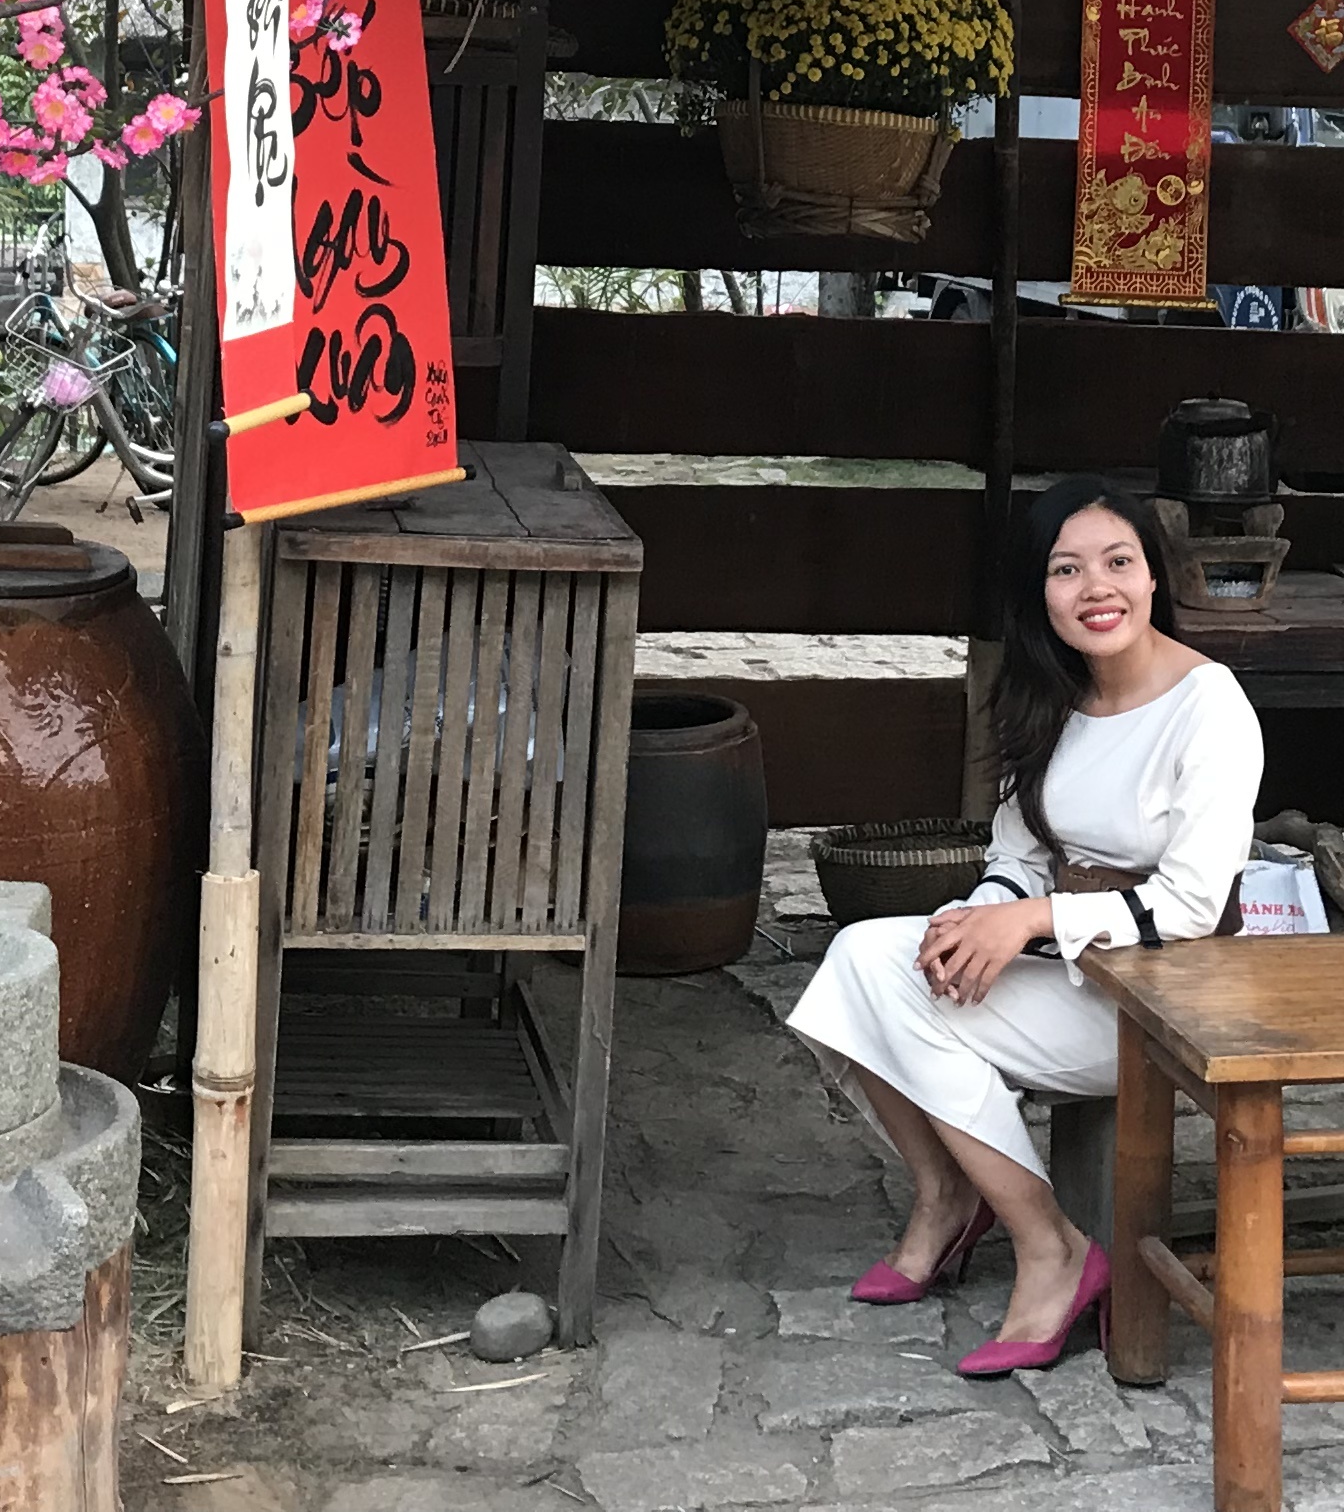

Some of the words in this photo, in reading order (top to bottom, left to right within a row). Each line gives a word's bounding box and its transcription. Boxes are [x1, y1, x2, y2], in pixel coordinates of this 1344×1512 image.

[1118, 28, 1183, 56] Phúc
[1131, 94, 1162, 133] An
[1120, 131, 1172, 164] Đến
